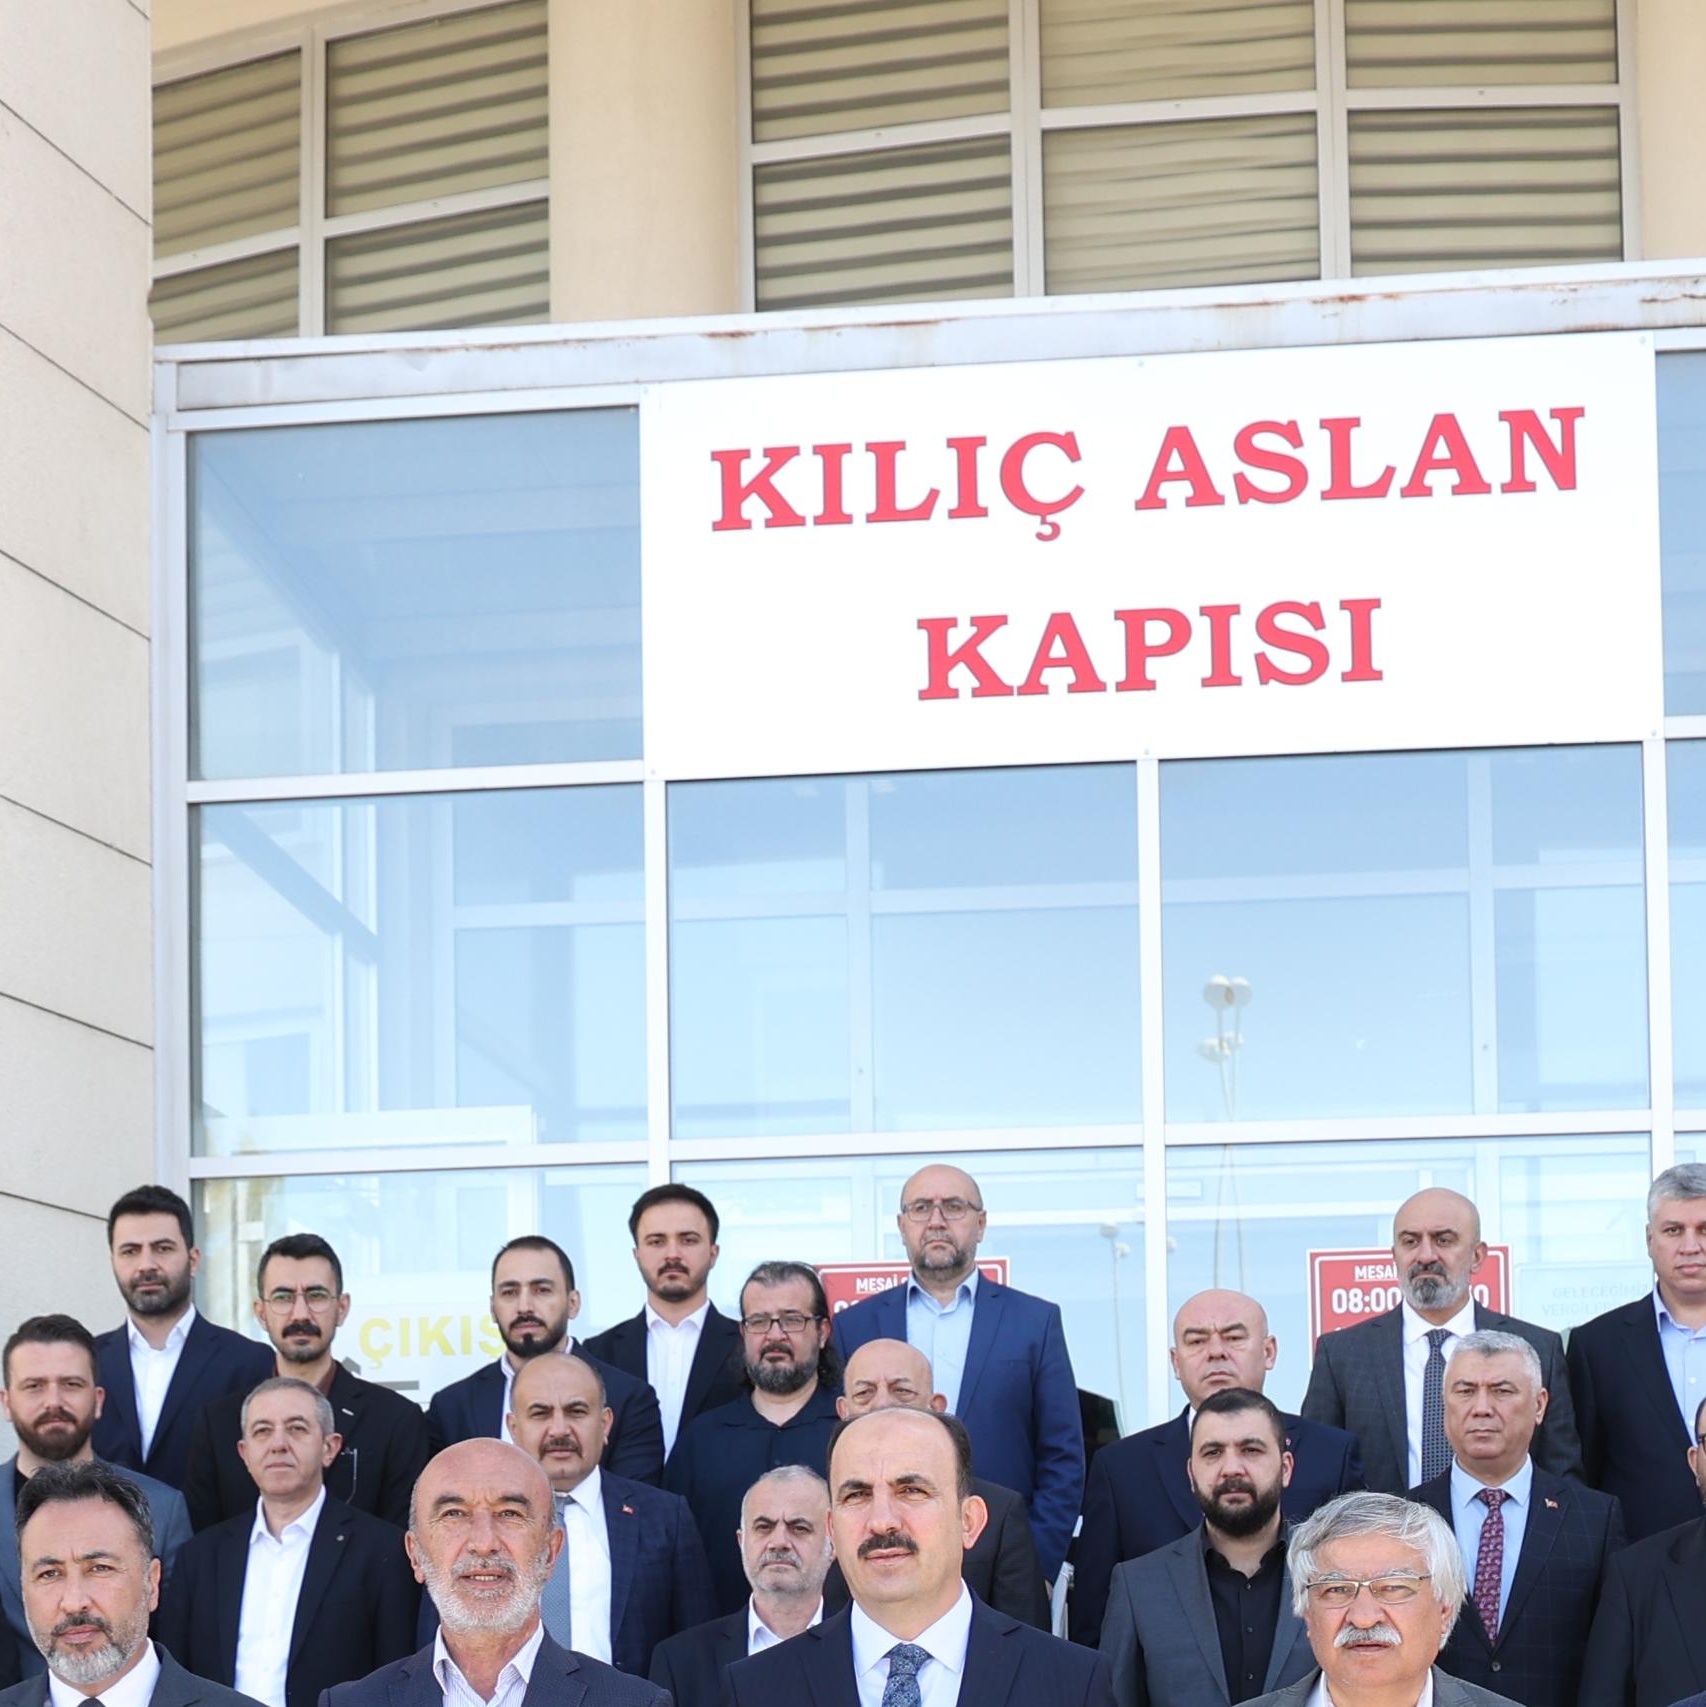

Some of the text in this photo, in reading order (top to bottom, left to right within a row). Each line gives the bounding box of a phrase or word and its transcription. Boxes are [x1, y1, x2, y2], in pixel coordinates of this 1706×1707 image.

[710, 405, 1586, 542] KILIÇ ASLAN
[917, 597, 1384, 701] KAPISI
